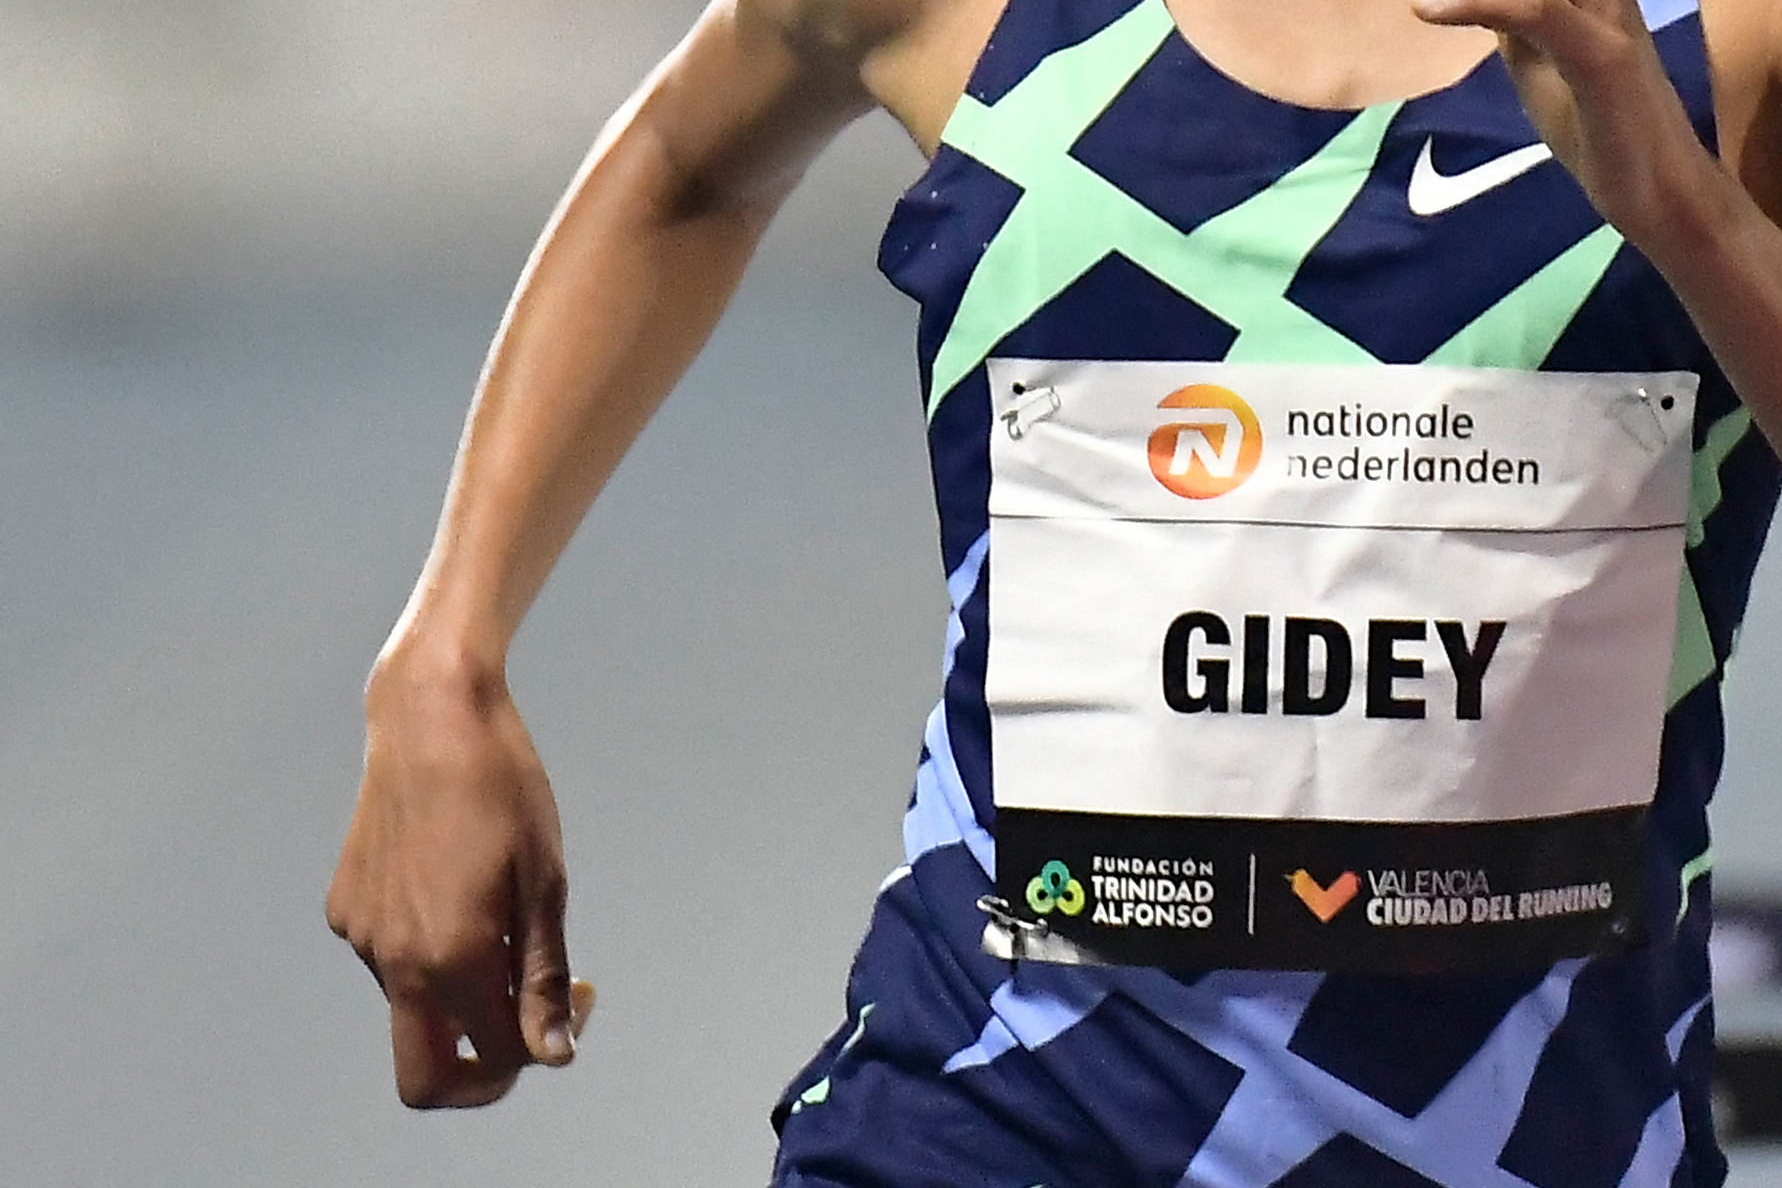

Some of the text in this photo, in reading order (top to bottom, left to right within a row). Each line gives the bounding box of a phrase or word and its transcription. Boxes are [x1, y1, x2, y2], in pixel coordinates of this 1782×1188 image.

[1287, 403, 1475, 439] nationale
[1287, 447, 1541, 485] nederlanden
[1163, 611, 1507, 720] GIDEY
[1092, 856, 1214, 876] FUNDACIÓN
[1092, 877, 1214, 903] TRINIDAD
[1367, 869, 1490, 897] VALENCIA
[1092, 902, 1214, 928] ALFONSO
[1367, 897, 1469, 925] CIUDAD
[1471, 896, 1514, 922] DEL
